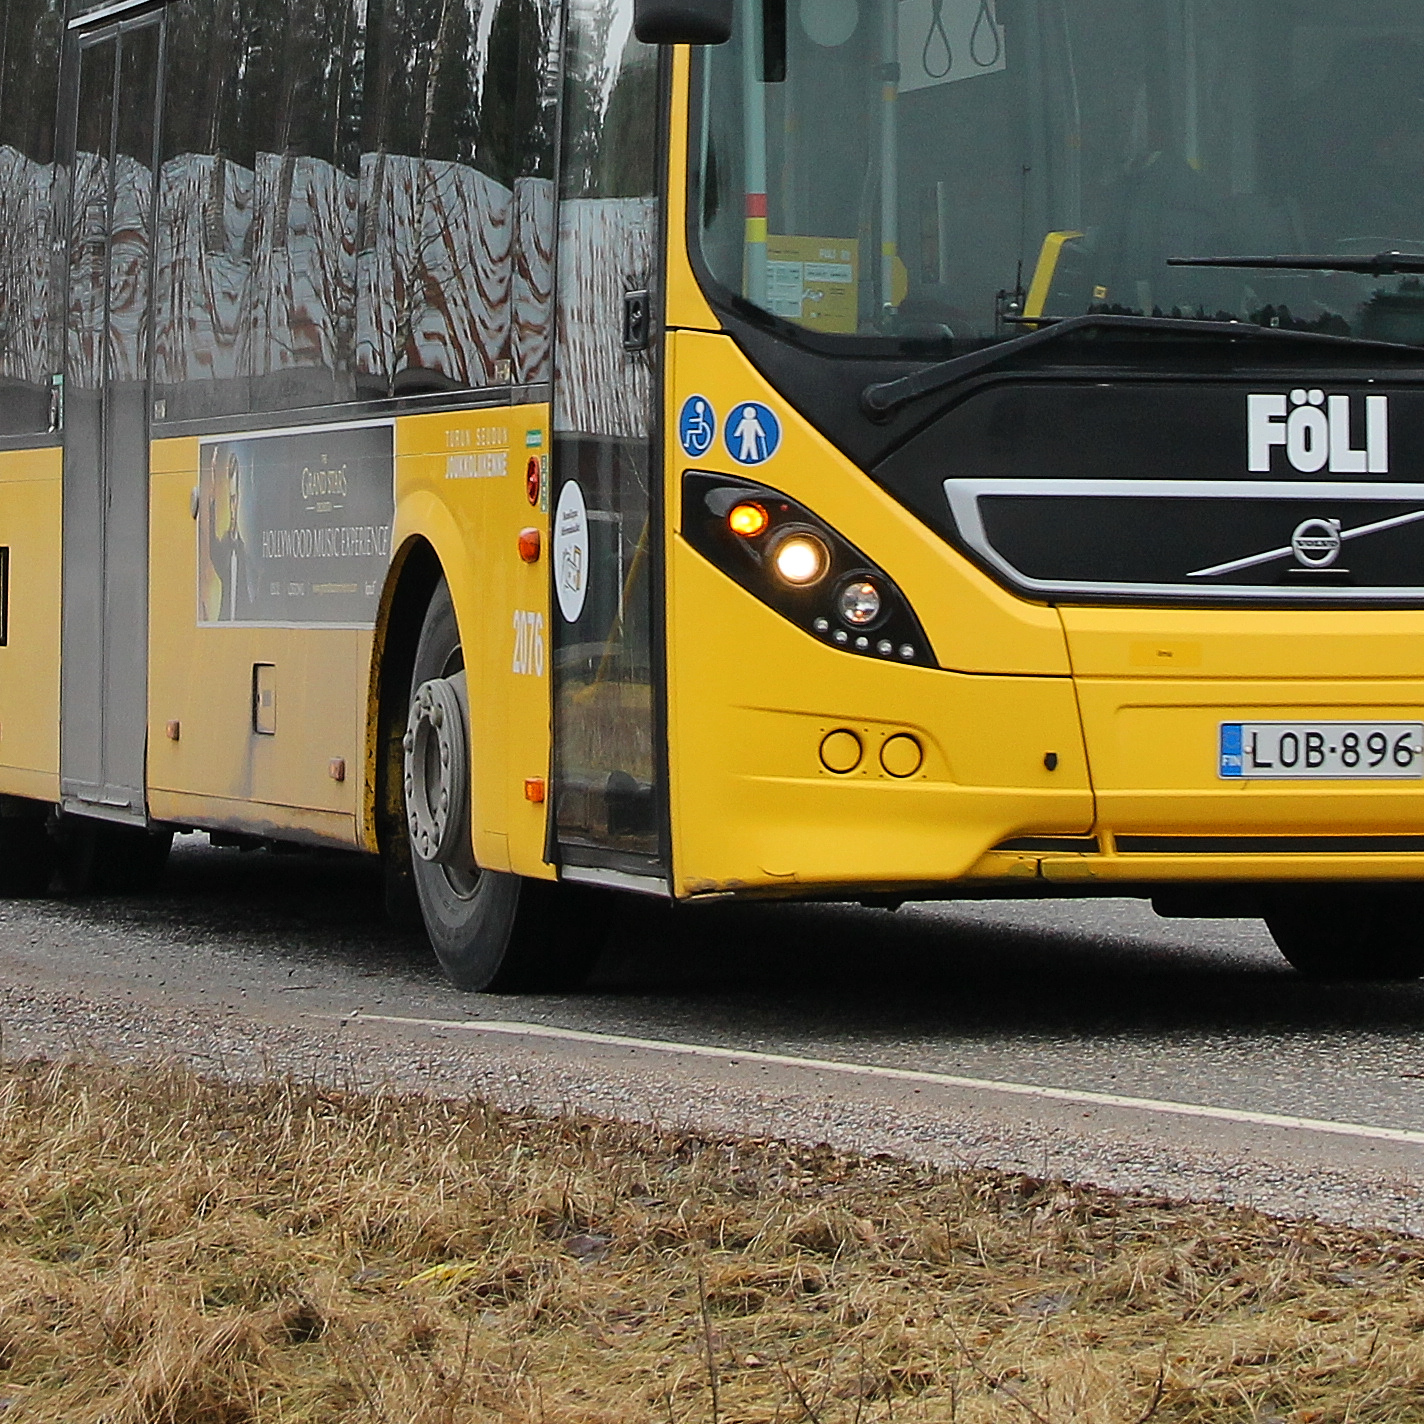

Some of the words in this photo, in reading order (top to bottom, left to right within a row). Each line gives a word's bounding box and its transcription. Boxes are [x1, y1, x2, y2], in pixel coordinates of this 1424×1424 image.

[1246, 388, 1388, 474] FÖLI
[262, 529, 312, 558] HOLLYWOOD
[313, 527, 339, 557] MUSIC
[341, 526, 389, 556] EXPERIENCE
[512, 610, 544, 677] 2076
[1252, 732, 1413, 768] LOB-896
